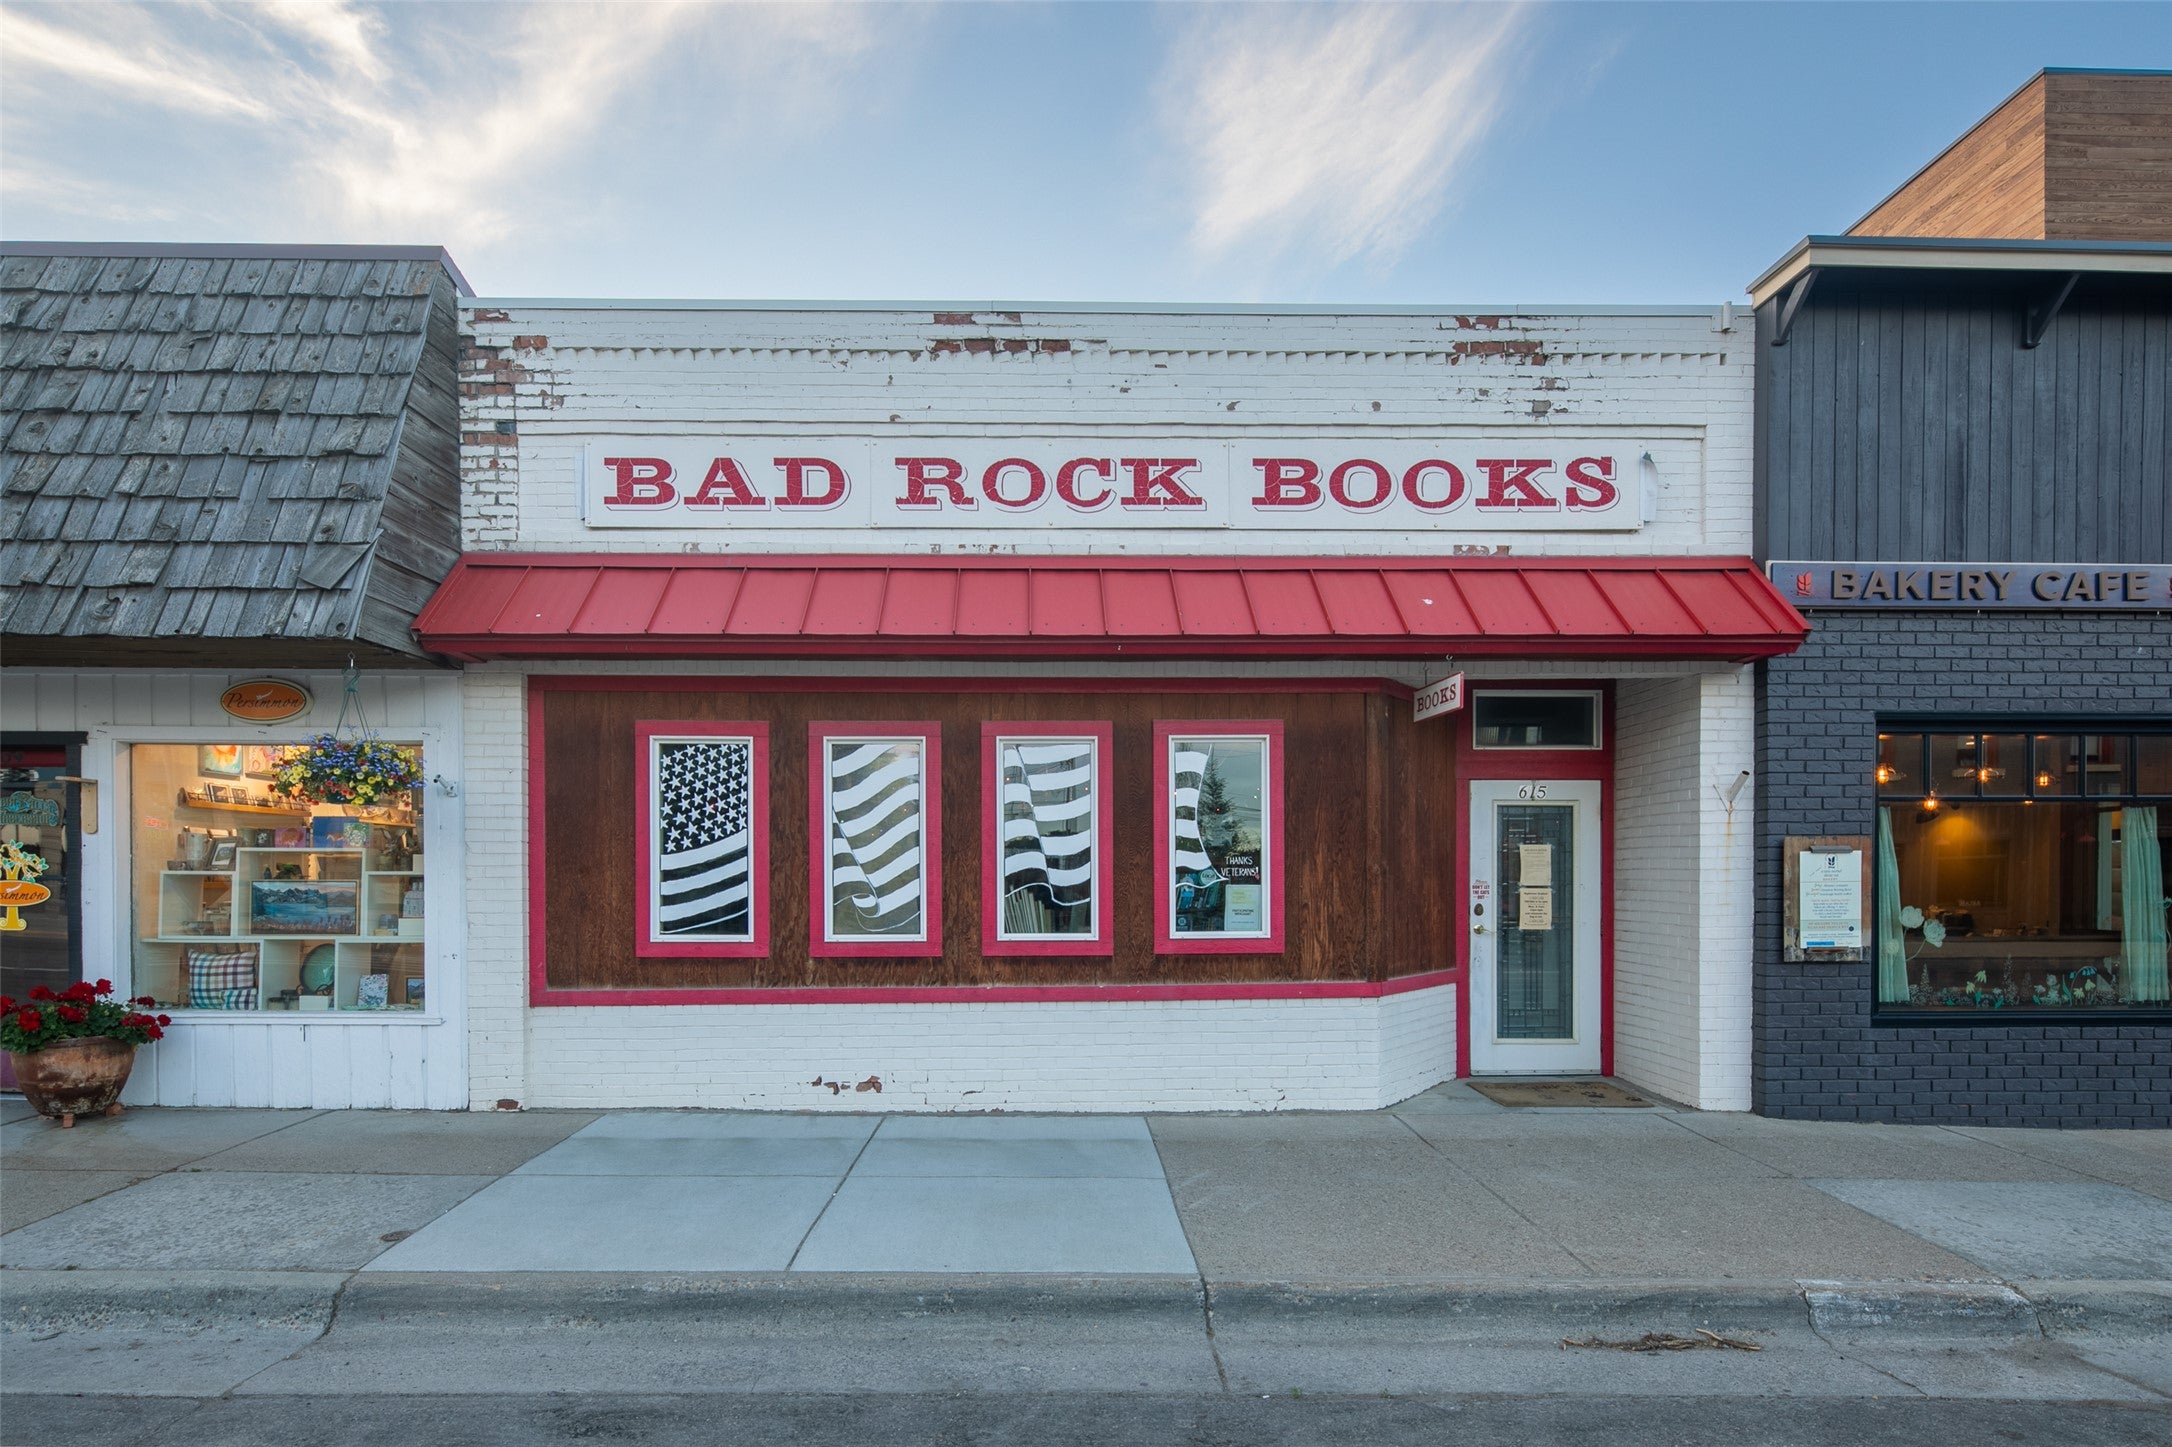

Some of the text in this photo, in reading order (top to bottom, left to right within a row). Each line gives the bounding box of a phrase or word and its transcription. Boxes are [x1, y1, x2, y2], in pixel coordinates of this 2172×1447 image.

[603, 456, 1621, 514] BAD ROCK BOOKS
[1831, 570, 2151, 602] BAKERY CAFE
[226, 692, 300, 708] Persimmon
[1417, 683, 1456, 712] BOOKS
[1519, 785, 1547, 799] 615
[1225, 856, 1253, 865] THANKS
